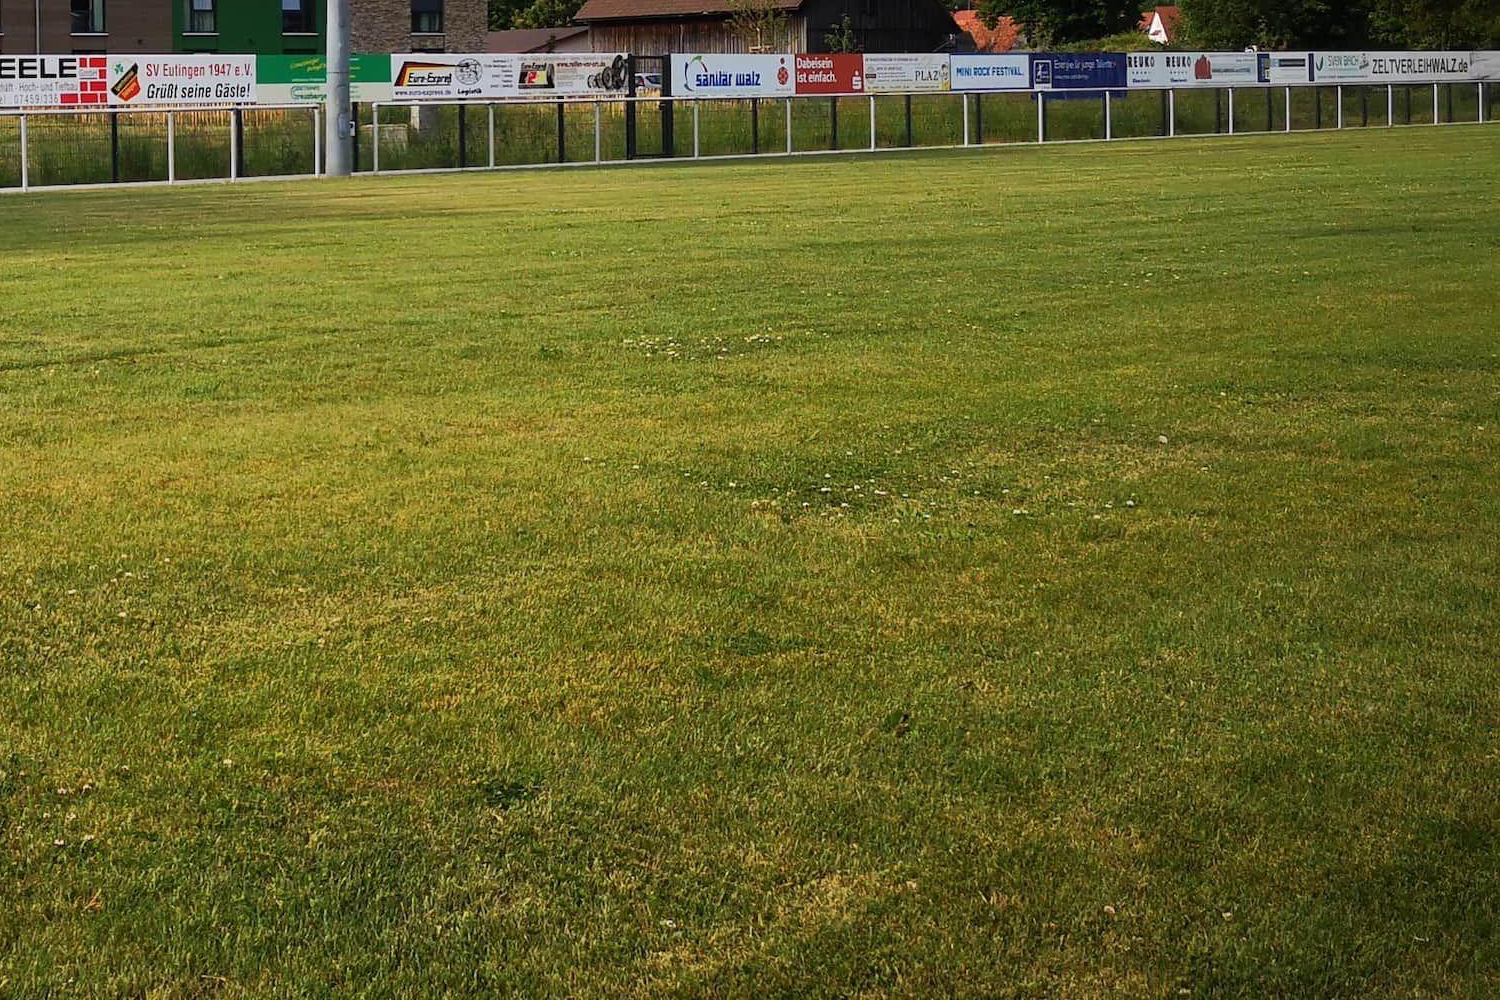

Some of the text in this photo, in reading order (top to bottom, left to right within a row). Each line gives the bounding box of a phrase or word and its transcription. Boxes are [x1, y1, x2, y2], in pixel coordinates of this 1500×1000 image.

[796, 57, 834, 70] Dabeisein
[1127, 56, 1155, 68] REUKO
[1166, 56, 1191, 67] REUKO
[1371, 58, 1468, 75] ZELTVERLEIHWALZ.de
[146, 64, 160, 77] SV
[163, 64, 205, 79] Eutingen
[208, 64, 231, 77] 1947
[797, 71, 837, 83] ist einfach.
[956, 67, 972, 77] MINI
[973, 67, 990, 76] ROCK
[735, 70, 761, 87] walz
[147, 83, 178, 99] Grüßt
[181, 83, 211, 99] seine
[215, 82, 251, 98] Gäste!
